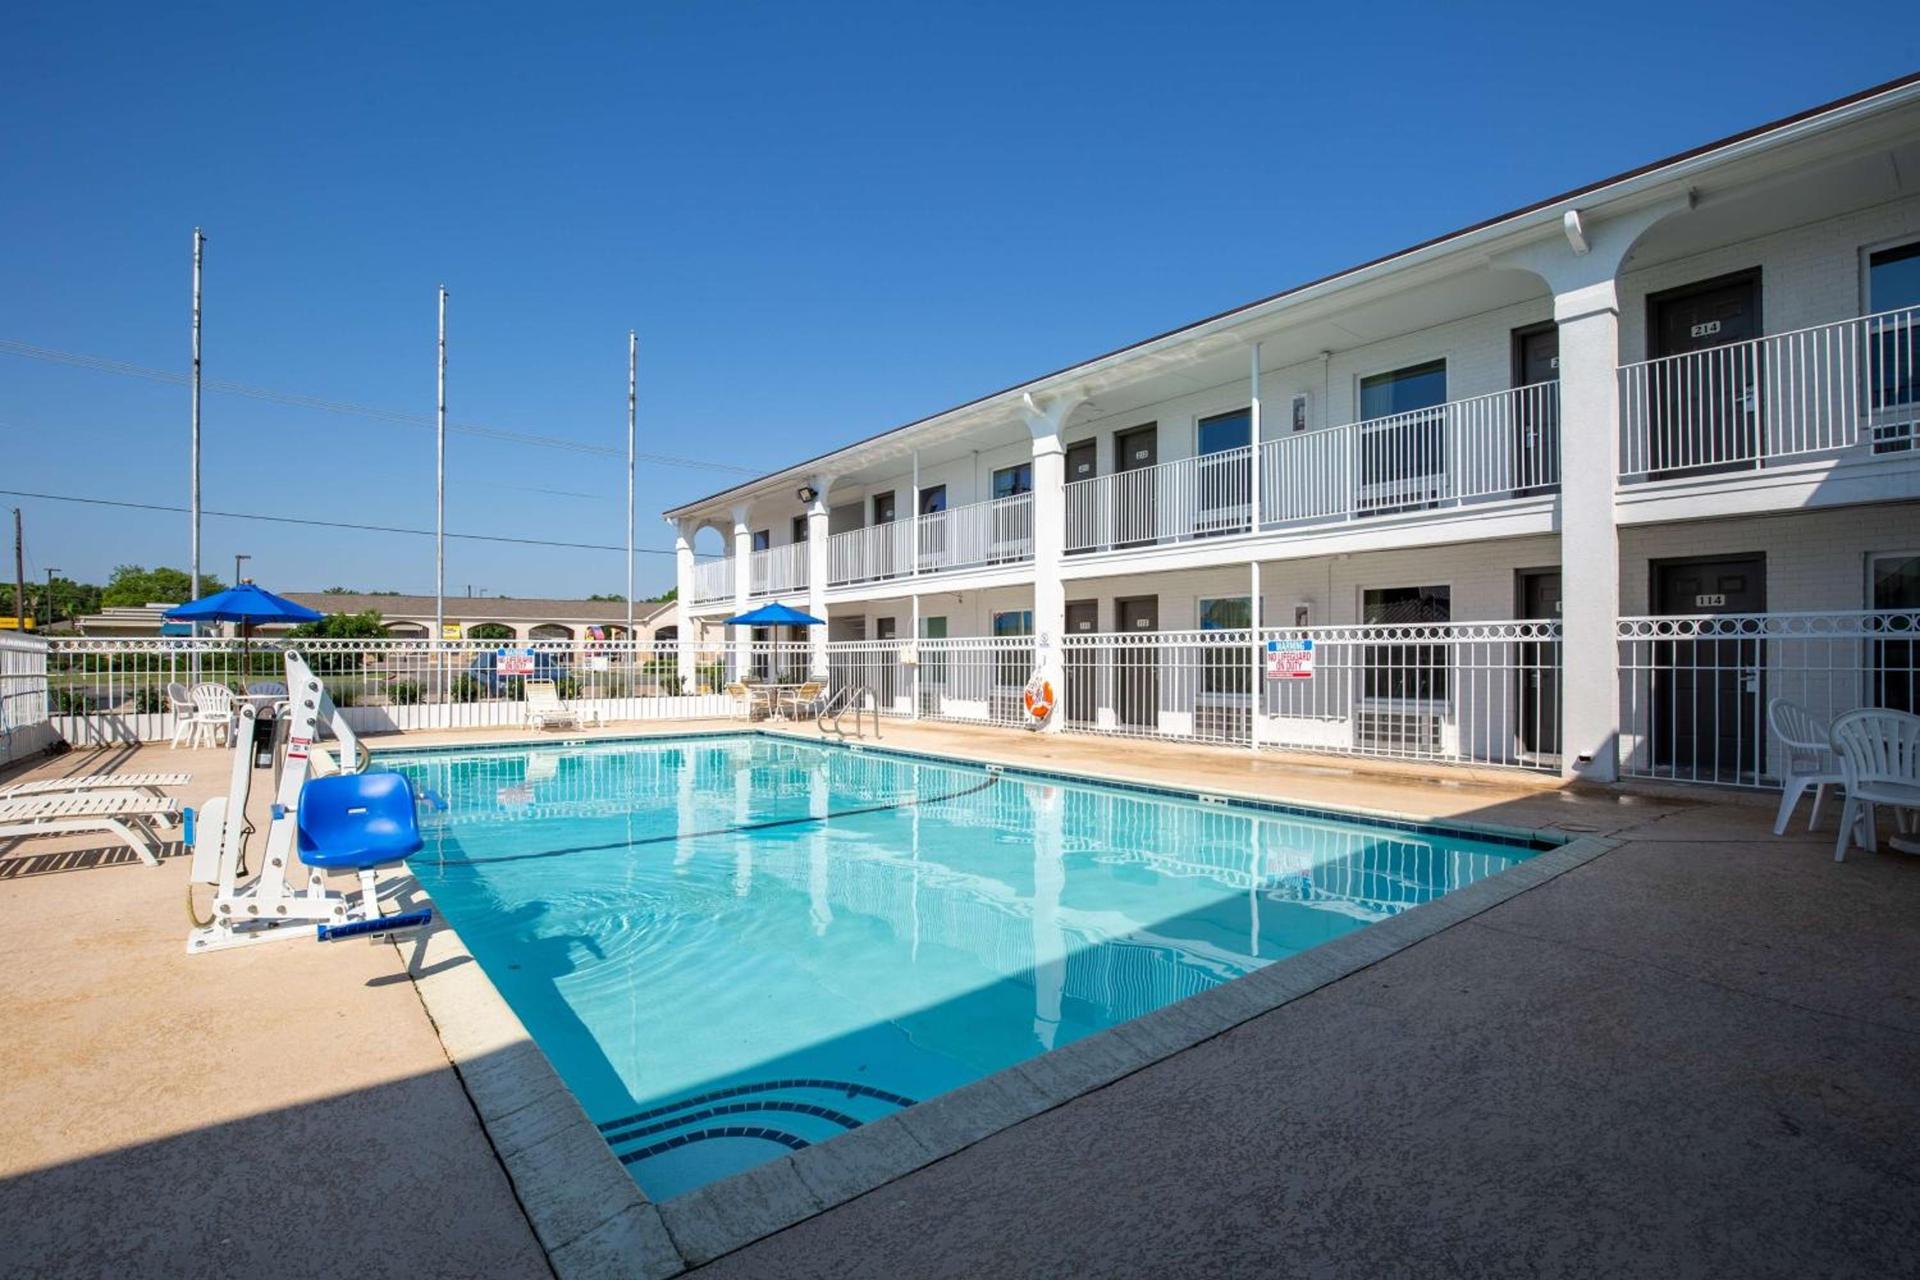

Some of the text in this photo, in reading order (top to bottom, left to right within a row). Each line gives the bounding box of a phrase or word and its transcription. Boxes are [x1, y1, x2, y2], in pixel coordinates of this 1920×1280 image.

[1694, 322, 1718, 336] 214
[1700, 596, 1721, 605] 114
[1268, 652, 1312, 661] NO LIFEGUARD
[1276, 660, 1302, 671] ON DUTY
